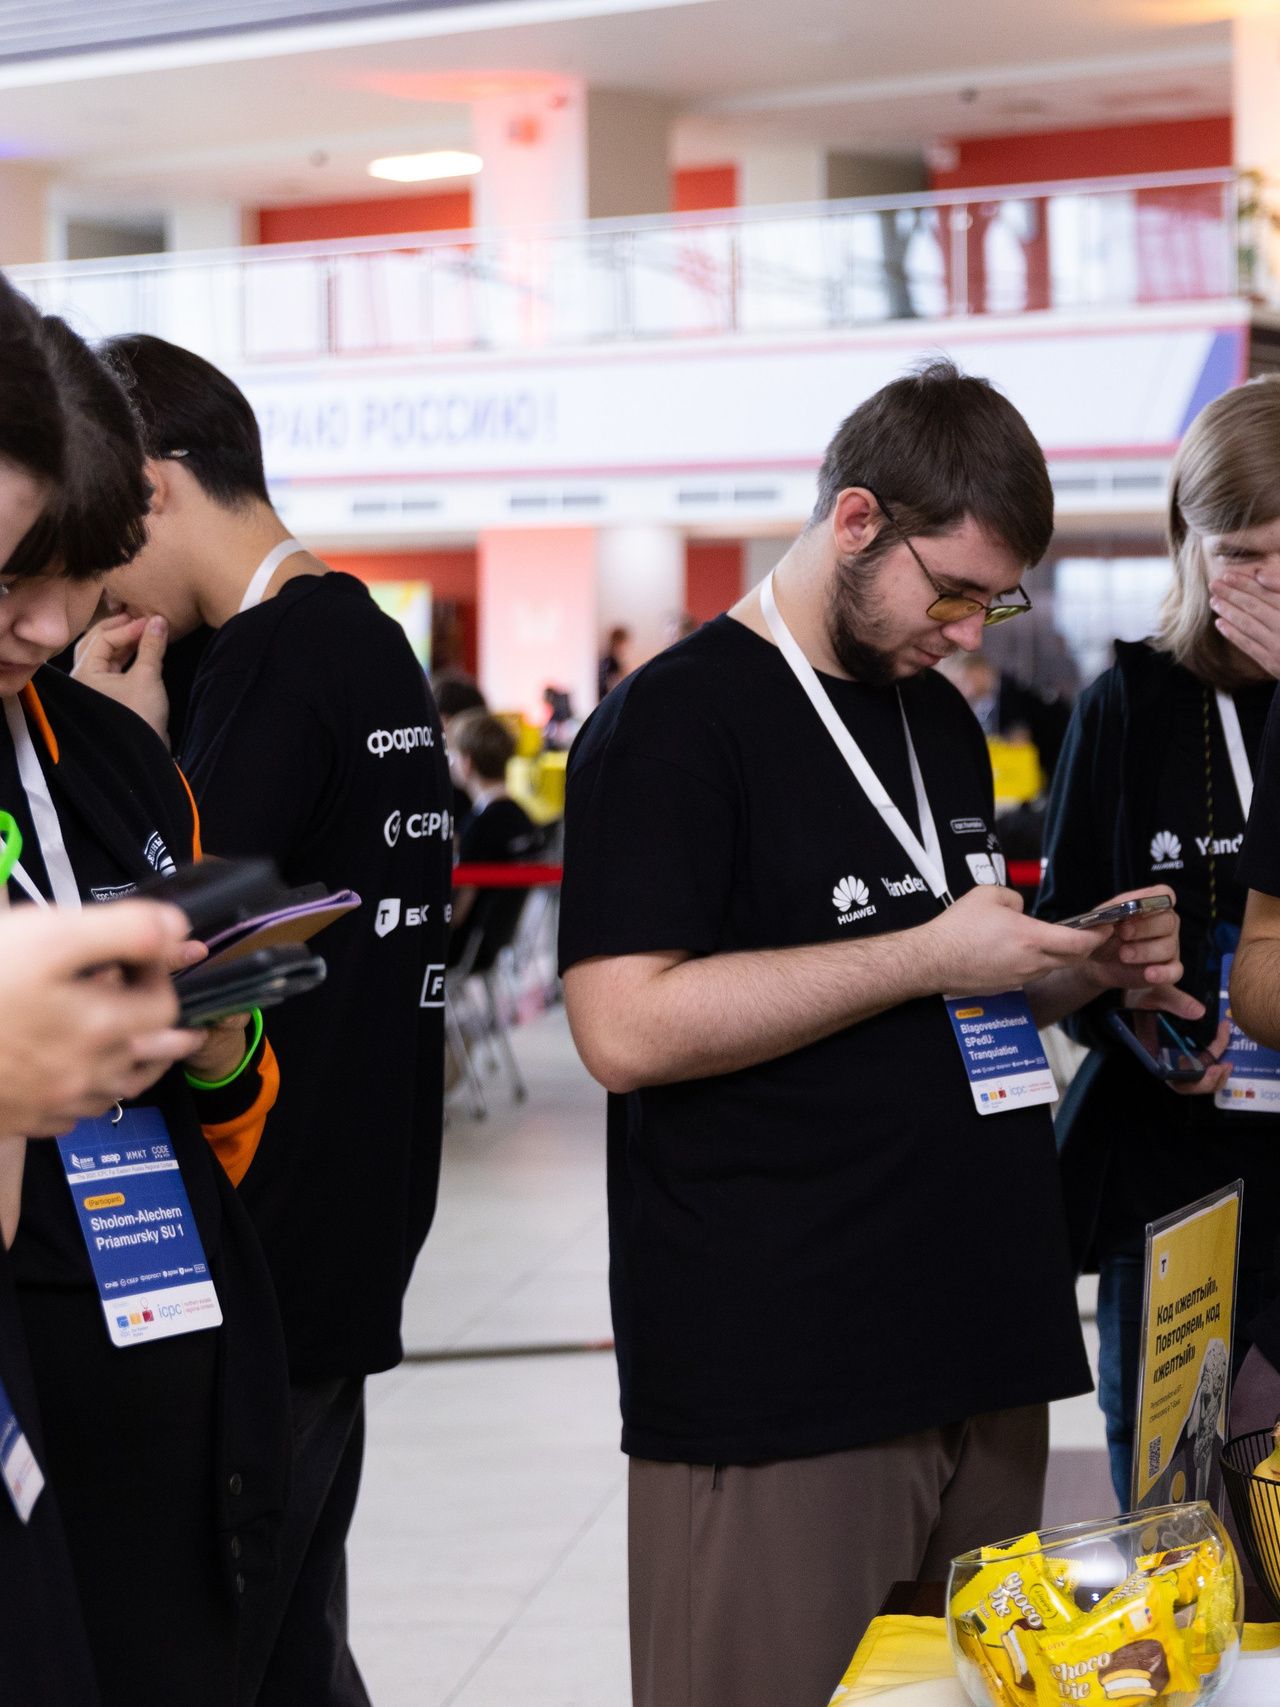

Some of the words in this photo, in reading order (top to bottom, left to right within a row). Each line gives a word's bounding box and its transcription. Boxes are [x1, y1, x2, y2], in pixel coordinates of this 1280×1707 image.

[262, 398, 348, 450] РАЮ
[367, 726, 434, 758] фарпо
[1195, 834, 1243, 856] Yand
[881, 874, 928, 897] Yandex
[837, 904, 877, 925] HUAWEI
[964, 1034, 995, 1048] SPedU:
[101, 1153, 121, 1164] asap
[126, 1149, 147, 1160] ИМКТ
[151, 1145, 170, 1154] CODE
[95, 1229, 159, 1250] Priamursky
[161, 1224, 176, 1239] SU
[177, 1224, 184, 1236] 1
[157, 1303, 183, 1319] icpc
[1157, 1303, 1173, 1327] Код
[1155, 1313, 1205, 1356] Повторяем,
[1205, 1302, 1220, 1324] код
[1153, 1343, 1195, 1384] «желтый»
[1003, 1571, 1043, 1627] Choco
[1049, 1652, 1111, 1682] Choco
